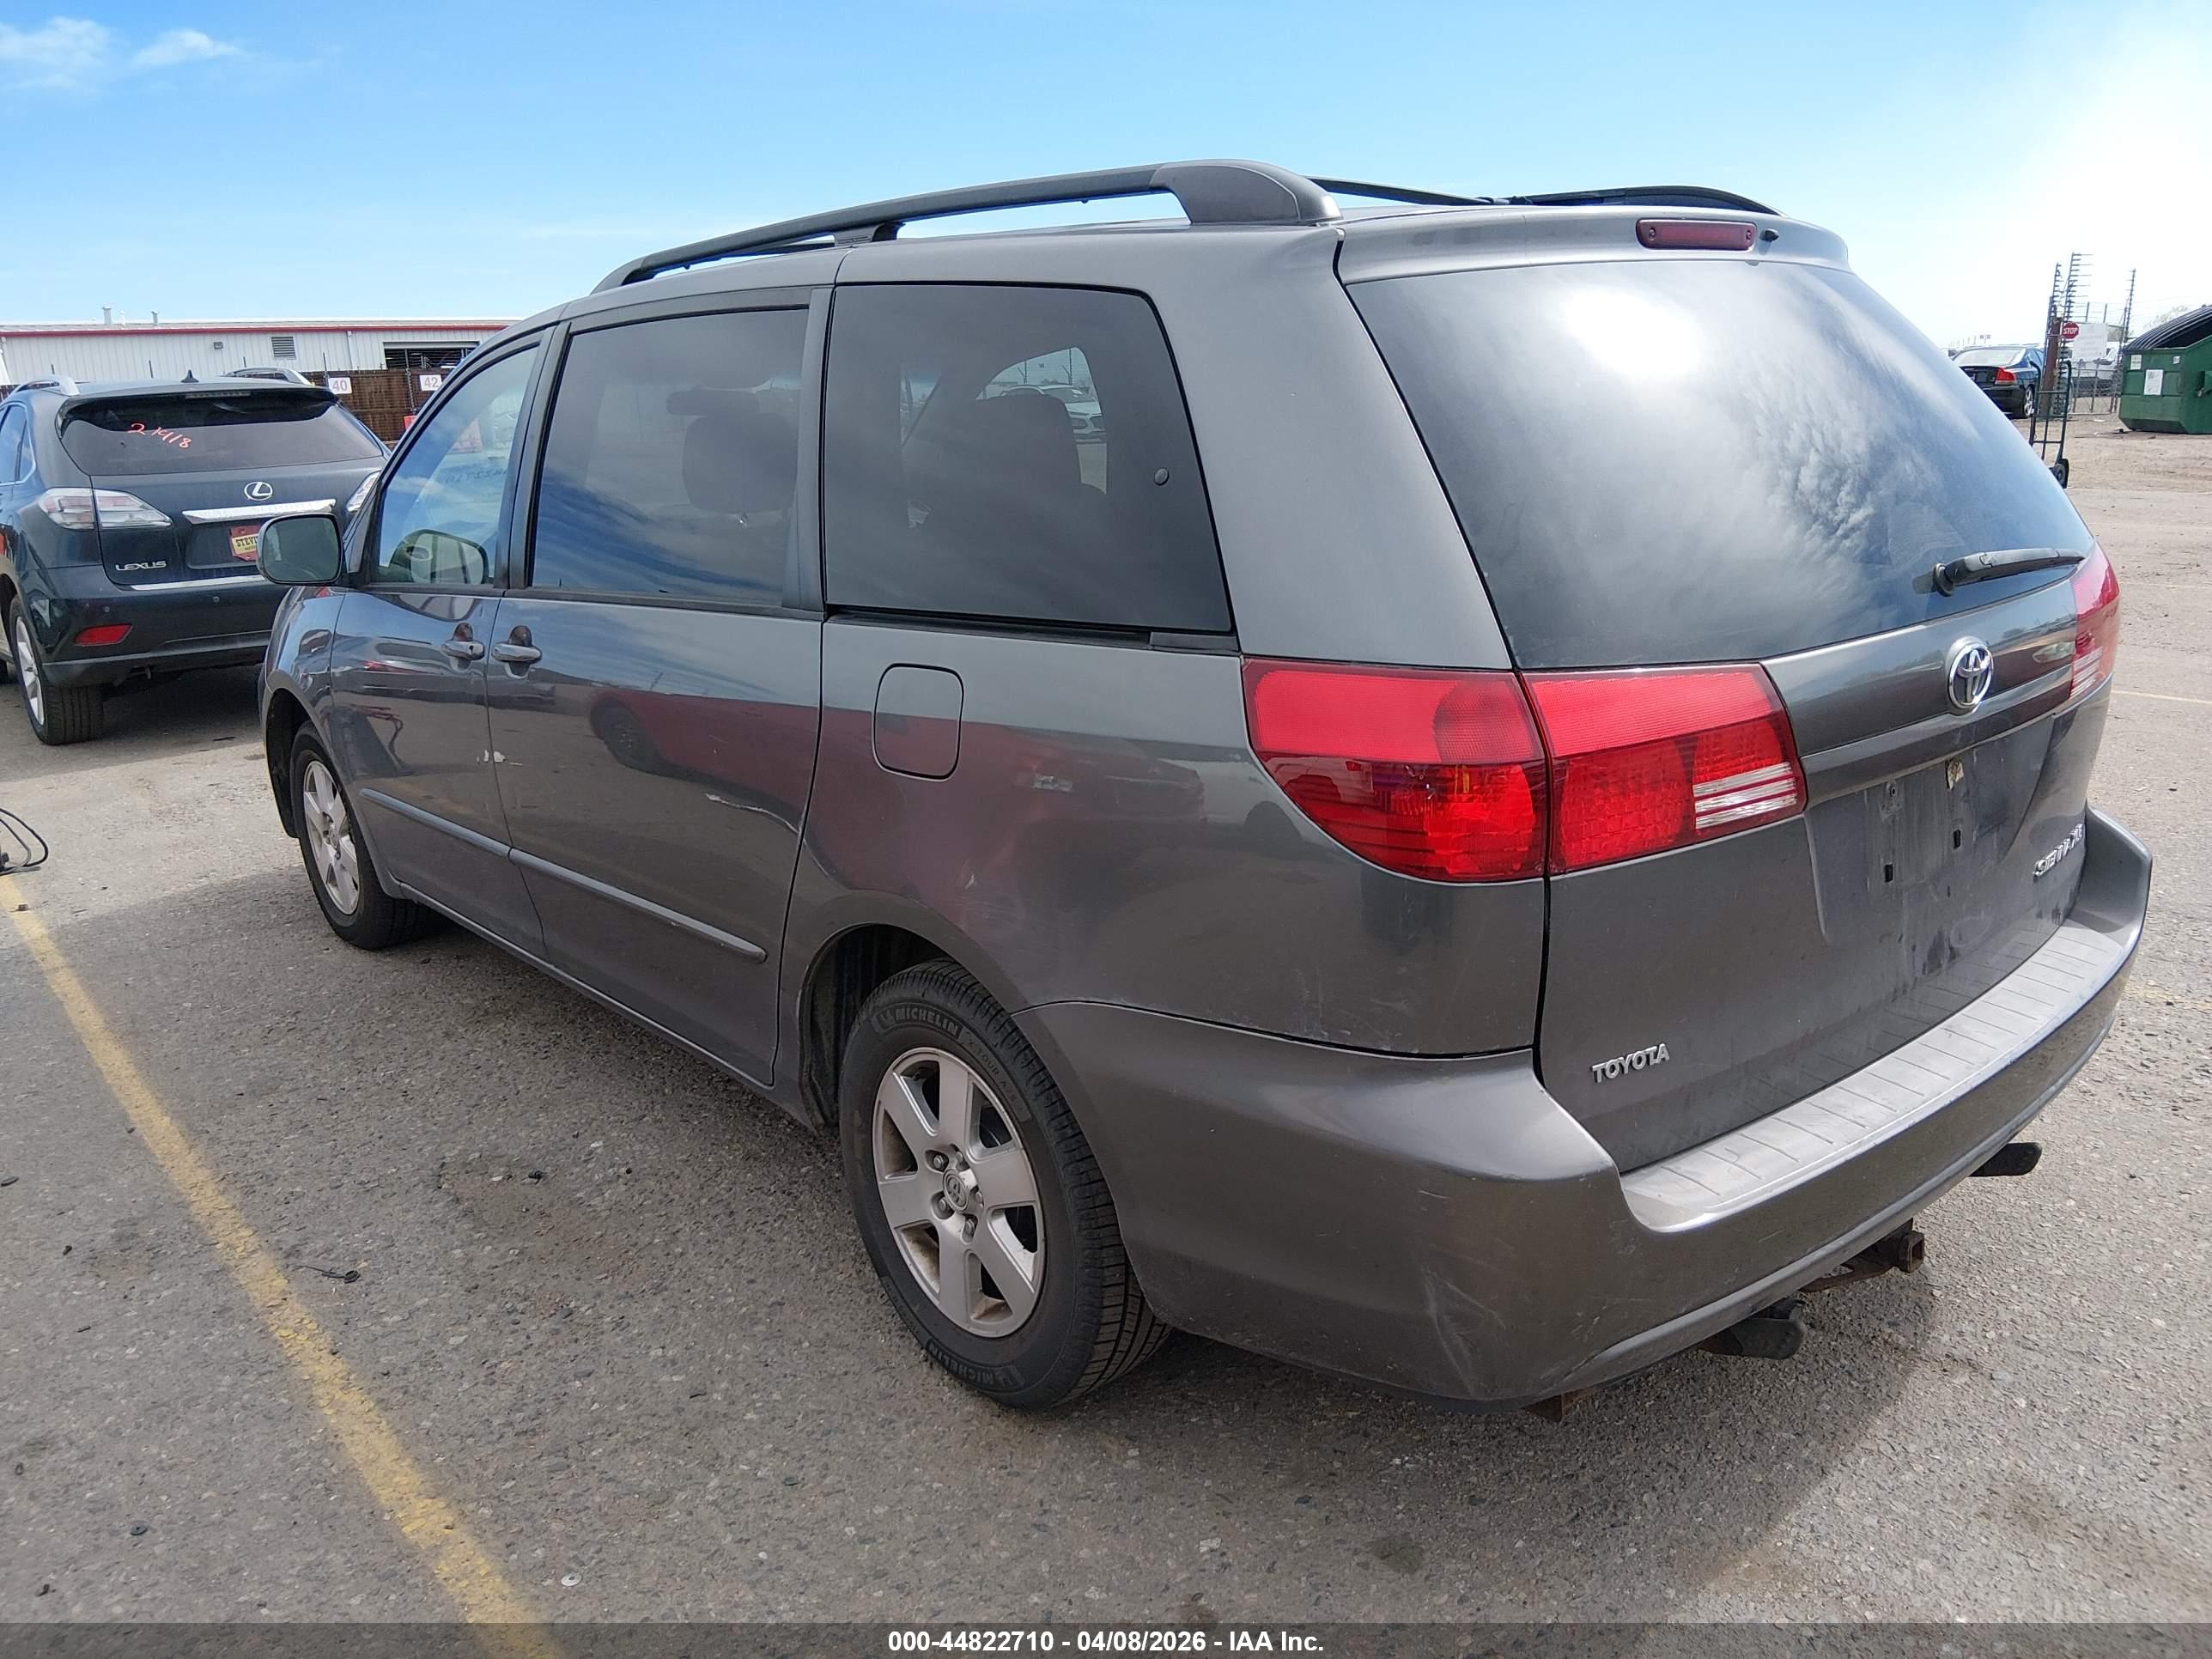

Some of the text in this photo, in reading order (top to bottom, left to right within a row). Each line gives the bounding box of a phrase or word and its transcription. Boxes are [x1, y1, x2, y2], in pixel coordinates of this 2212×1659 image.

[332, 380, 348, 392] 40
[424, 377, 439, 388] 42
[235, 537, 258, 547] STEVI
[115, 561, 167, 571] LEXUS
[895, 1006, 959, 1038] MICHELIN
[977, 1048, 1000, 1076] TOUR
[1591, 1042, 1670, 1083] TOYOTA
